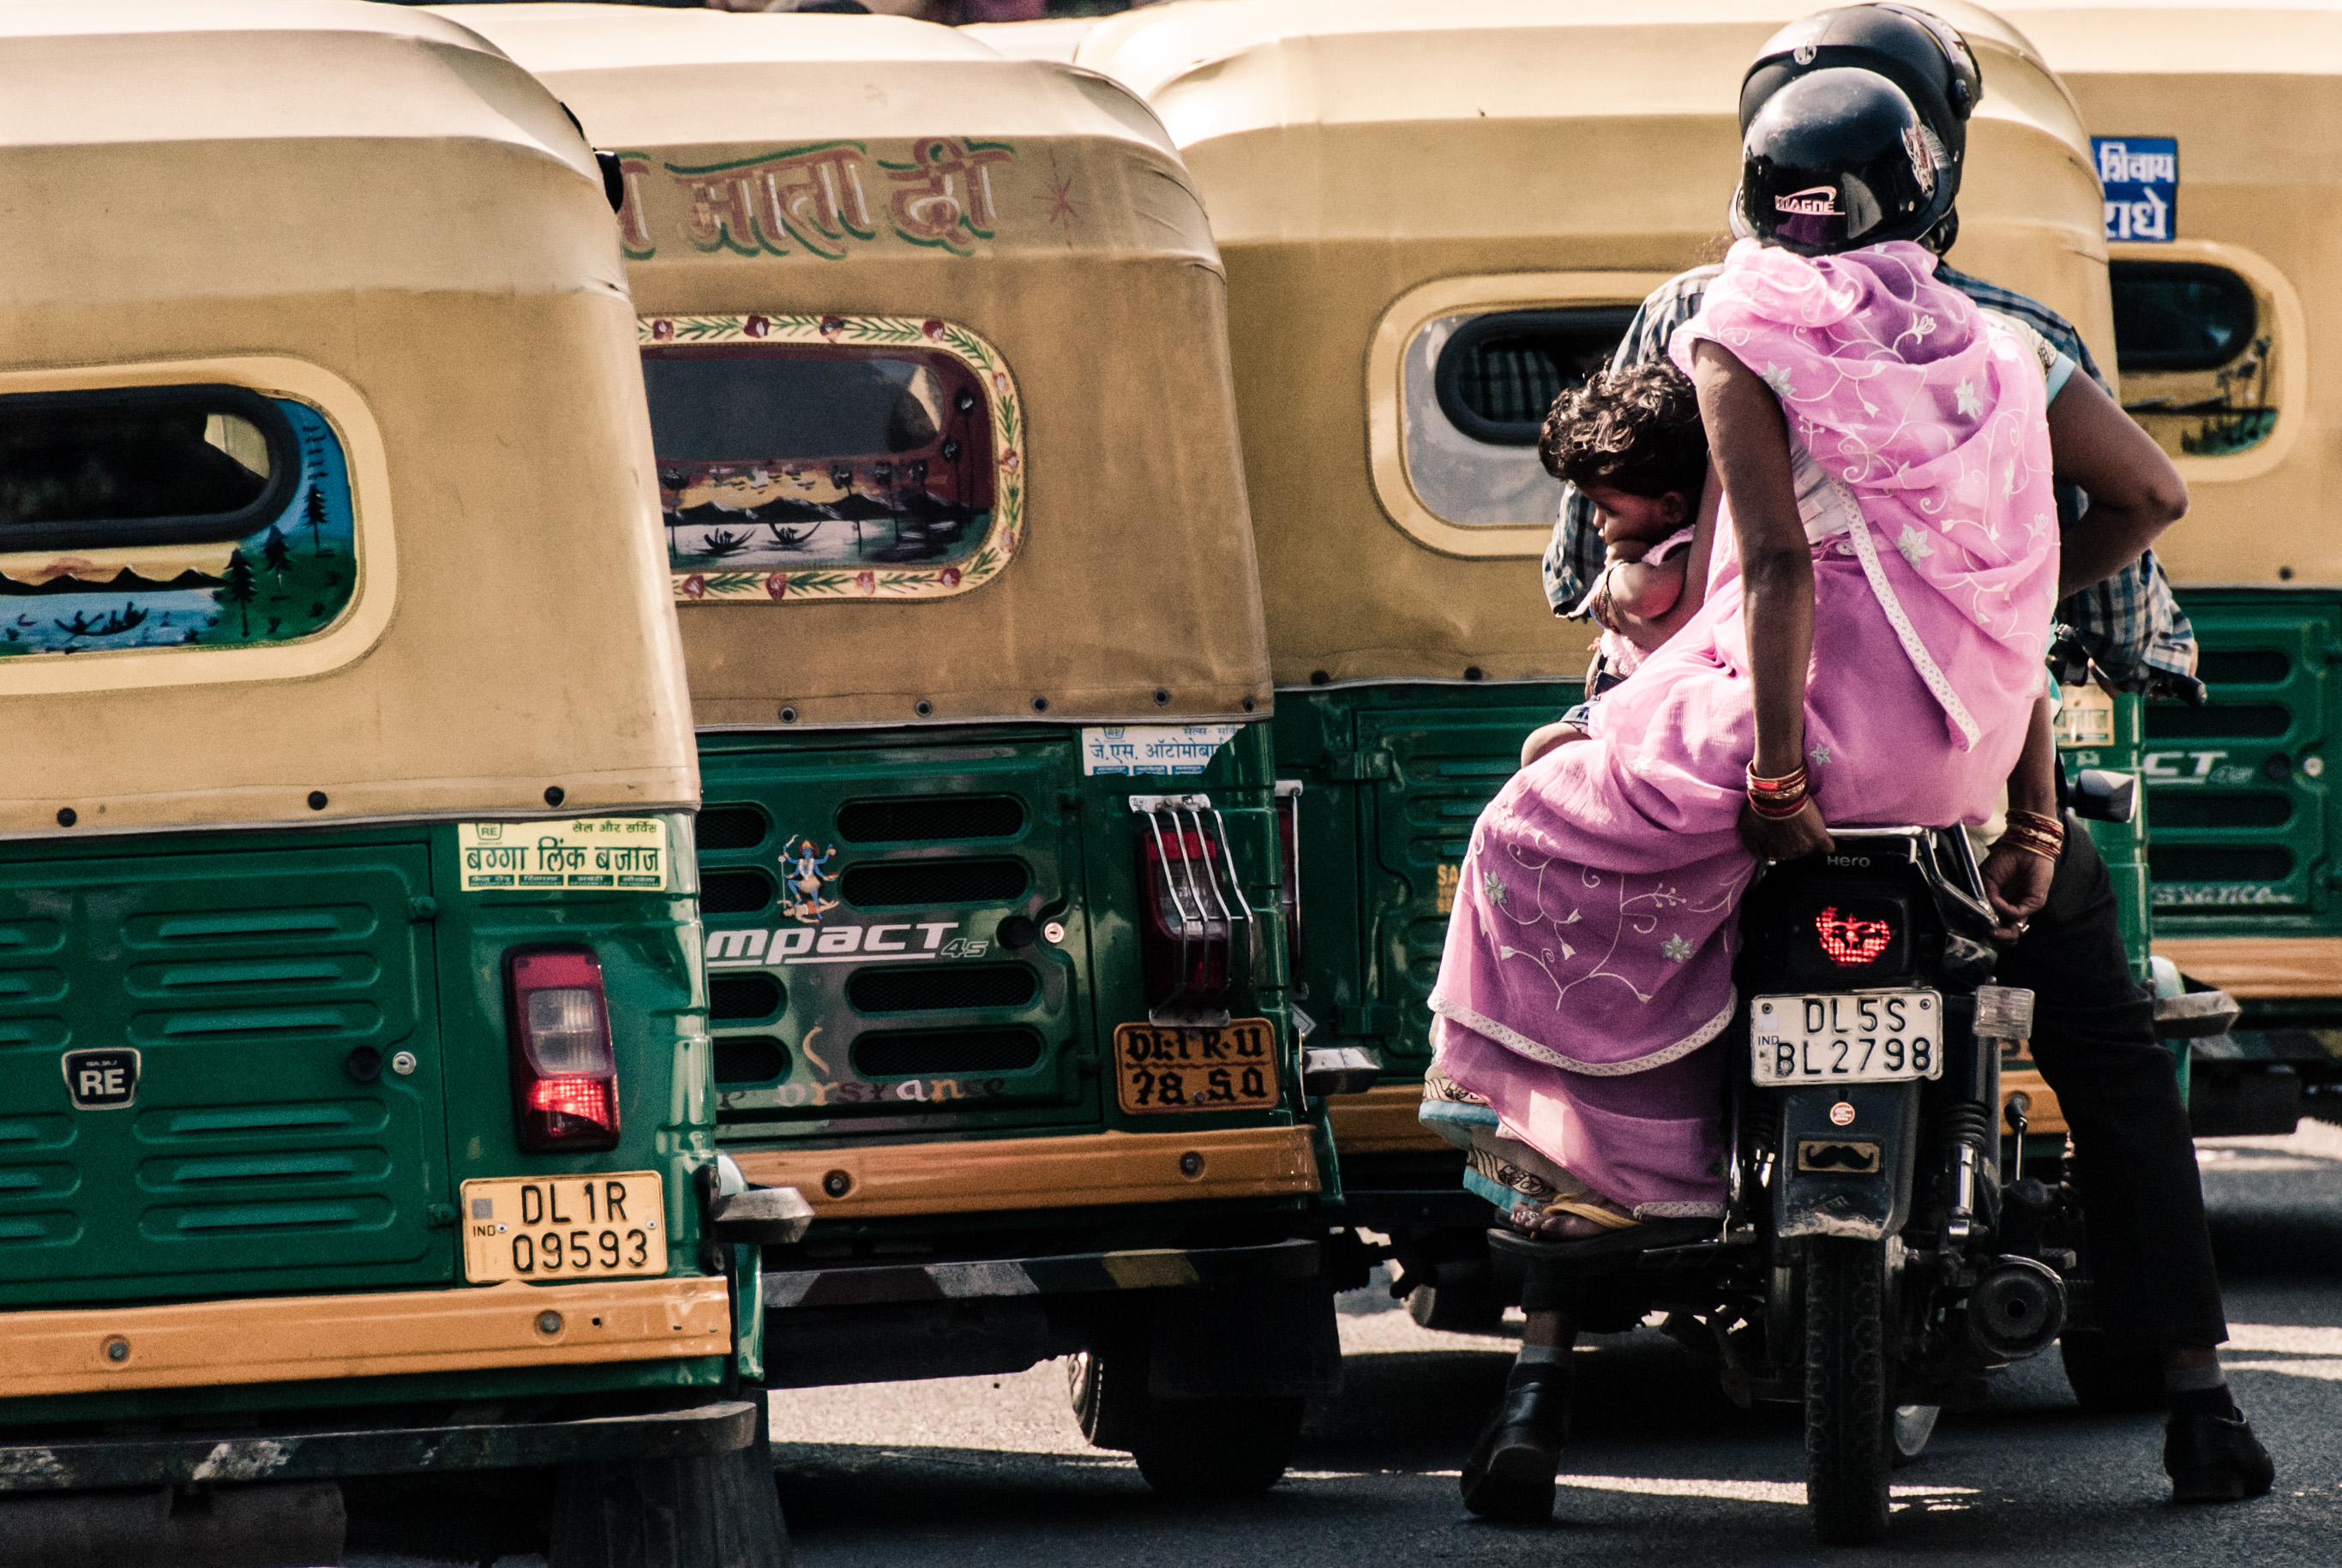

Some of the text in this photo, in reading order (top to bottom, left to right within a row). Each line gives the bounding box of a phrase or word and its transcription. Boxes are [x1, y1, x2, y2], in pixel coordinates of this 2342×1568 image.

[481, 827, 498, 836] RE
[573, 820, 658, 833] सेल और सर्विस
[537, 836, 587, 872] लिंक
[1827, 856, 1871, 868] Hero
[1802, 998, 1907, 1034] DL5S
[1757, 1035, 1780, 1046] IND
[1775, 1037, 1931, 1078] BL2798
[80, 1068, 126, 1096] RE
[472, 1224, 495, 1237] IND
[513, 1229, 647, 1273] 09593
